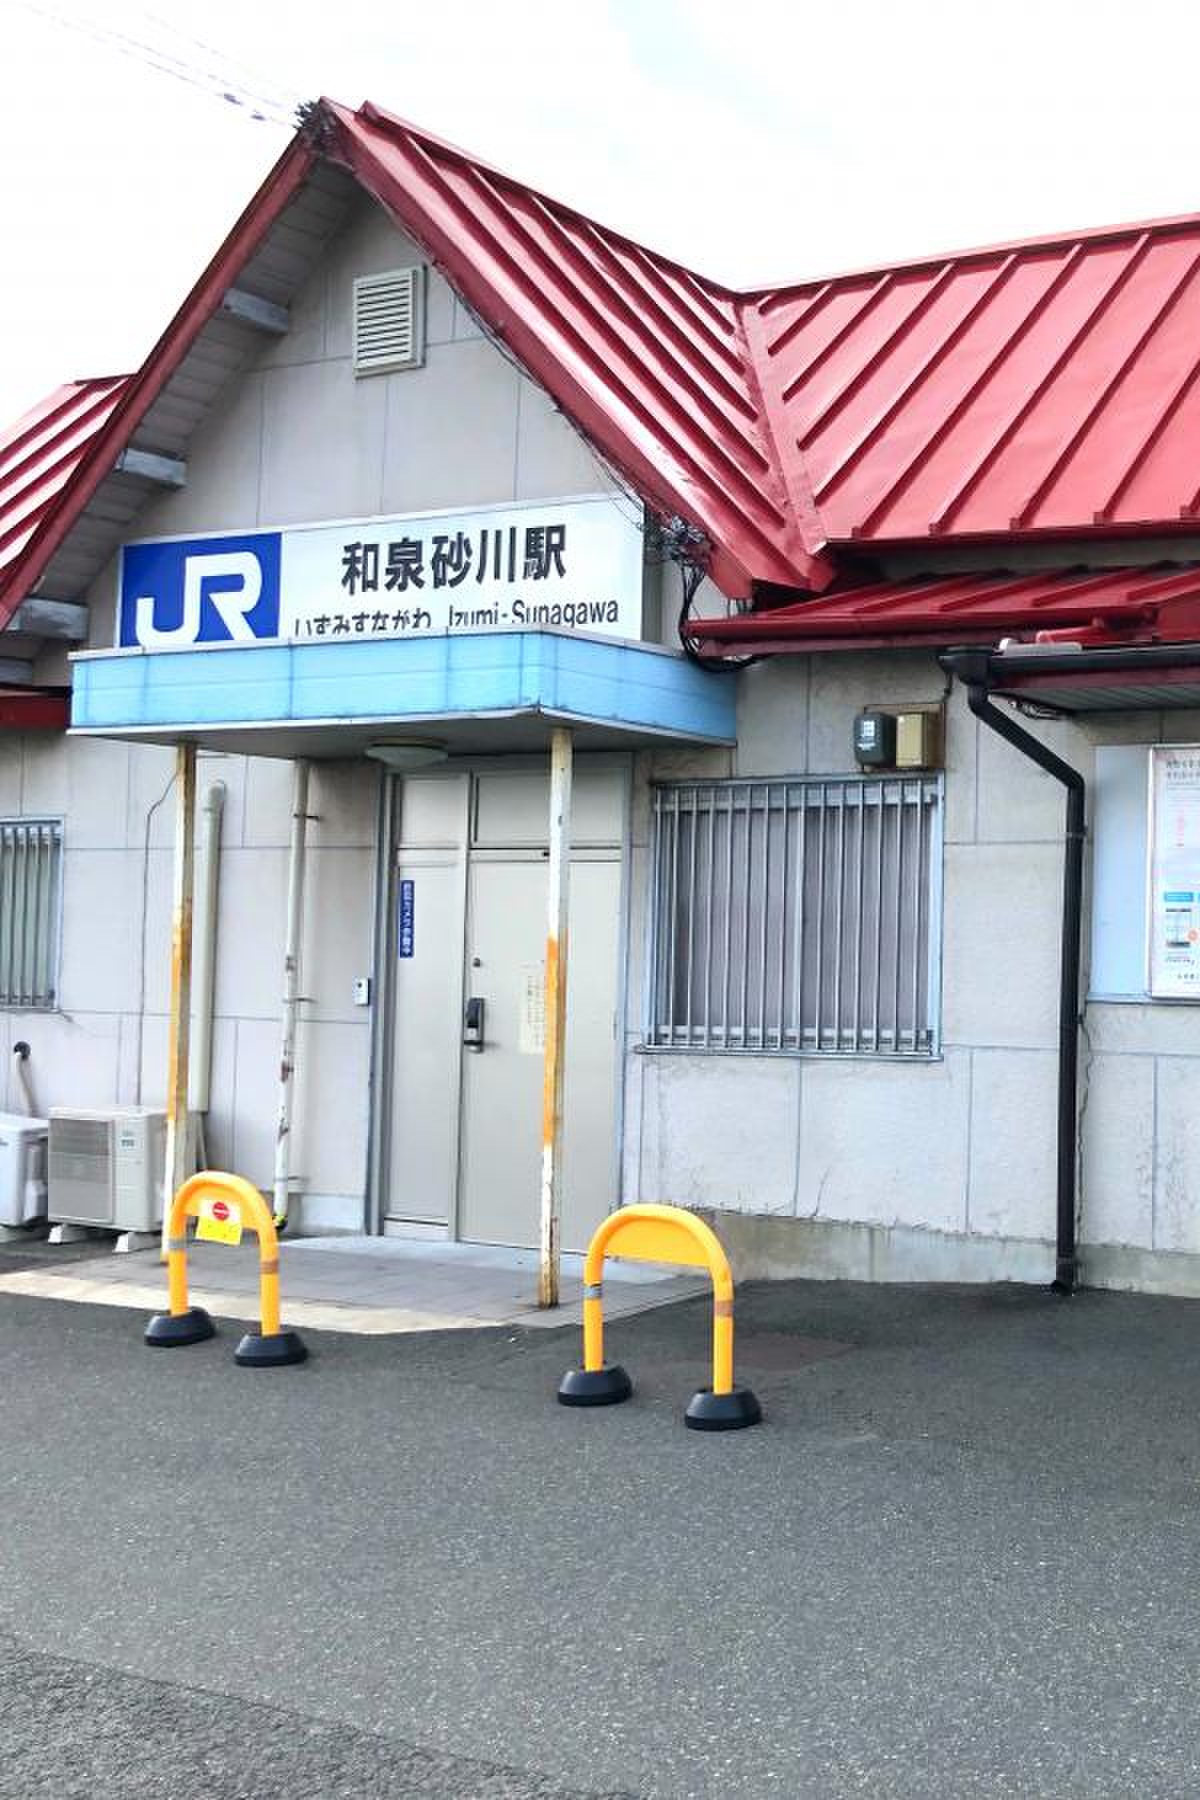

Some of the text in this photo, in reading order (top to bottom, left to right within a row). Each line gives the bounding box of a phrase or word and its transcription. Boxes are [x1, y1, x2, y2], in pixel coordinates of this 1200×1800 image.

[136, 551, 262, 645] JR
[341, 524, 567, 596] 和泉砂川駅
